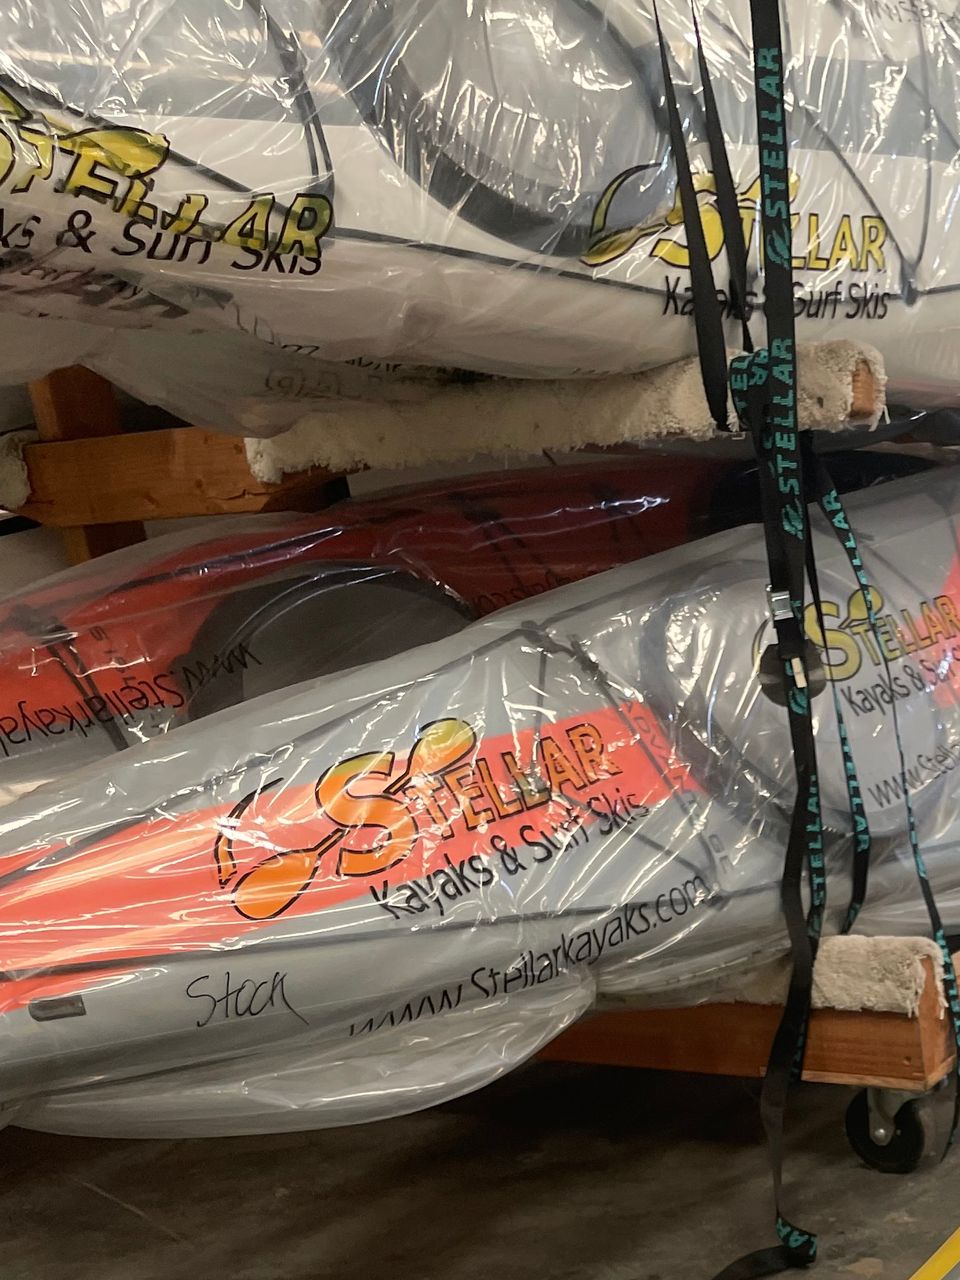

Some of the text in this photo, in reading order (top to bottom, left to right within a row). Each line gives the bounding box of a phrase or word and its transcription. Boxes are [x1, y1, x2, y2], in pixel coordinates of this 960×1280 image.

[757, 47, 790, 219] STELLAR
[844, 282, 890, 319] Skis
[772, 337, 801, 496] STELLAR
[316, 722, 624, 877] STELLAR
[369, 855, 494, 919] Kayaks
[500, 834, 527, 876] &
